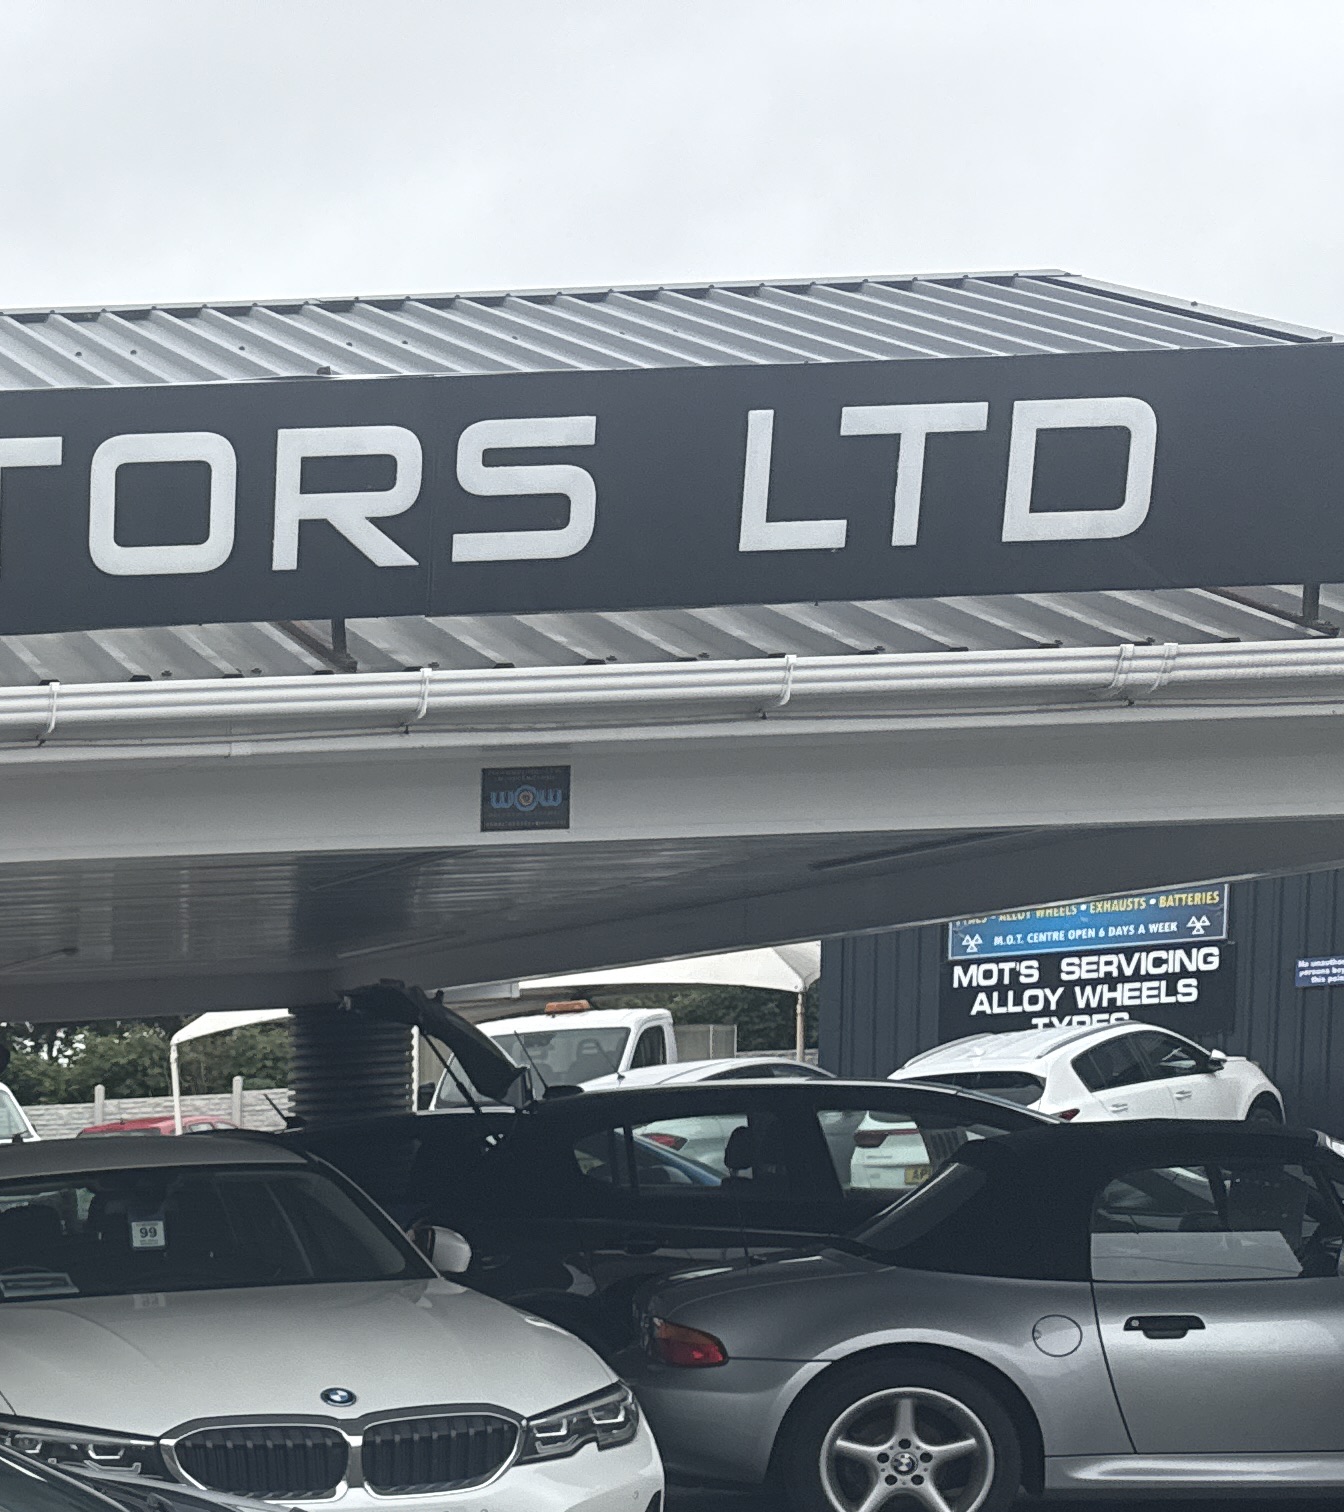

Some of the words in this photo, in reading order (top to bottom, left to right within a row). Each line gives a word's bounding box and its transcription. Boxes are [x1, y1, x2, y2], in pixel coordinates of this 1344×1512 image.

[739, 397, 1157, 552] LTD
[1035, 904, 1078, 918] WHEELS
[1089, 897, 1147, 914] EXHAUSTS
[1158, 891, 1220, 908] BATTERIES
[1027, 930, 1065, 944] CENTRE
[1068, 927, 1095, 941] OPEN
[1098, 927, 1105, 938] 6
[1108, 924, 1135, 937] DAYS
[1137, 923, 1146, 935] A
[1148, 922, 1178, 933] WEEK
[952, 960, 1039, 988] MOT'S
[1060, 946, 1220, 981] SERVICING
[970, 986, 1065, 1016] ALLOY
[1075, 978, 1198, 1008] WHEELS
[139, 1226, 158, 1239] 99
